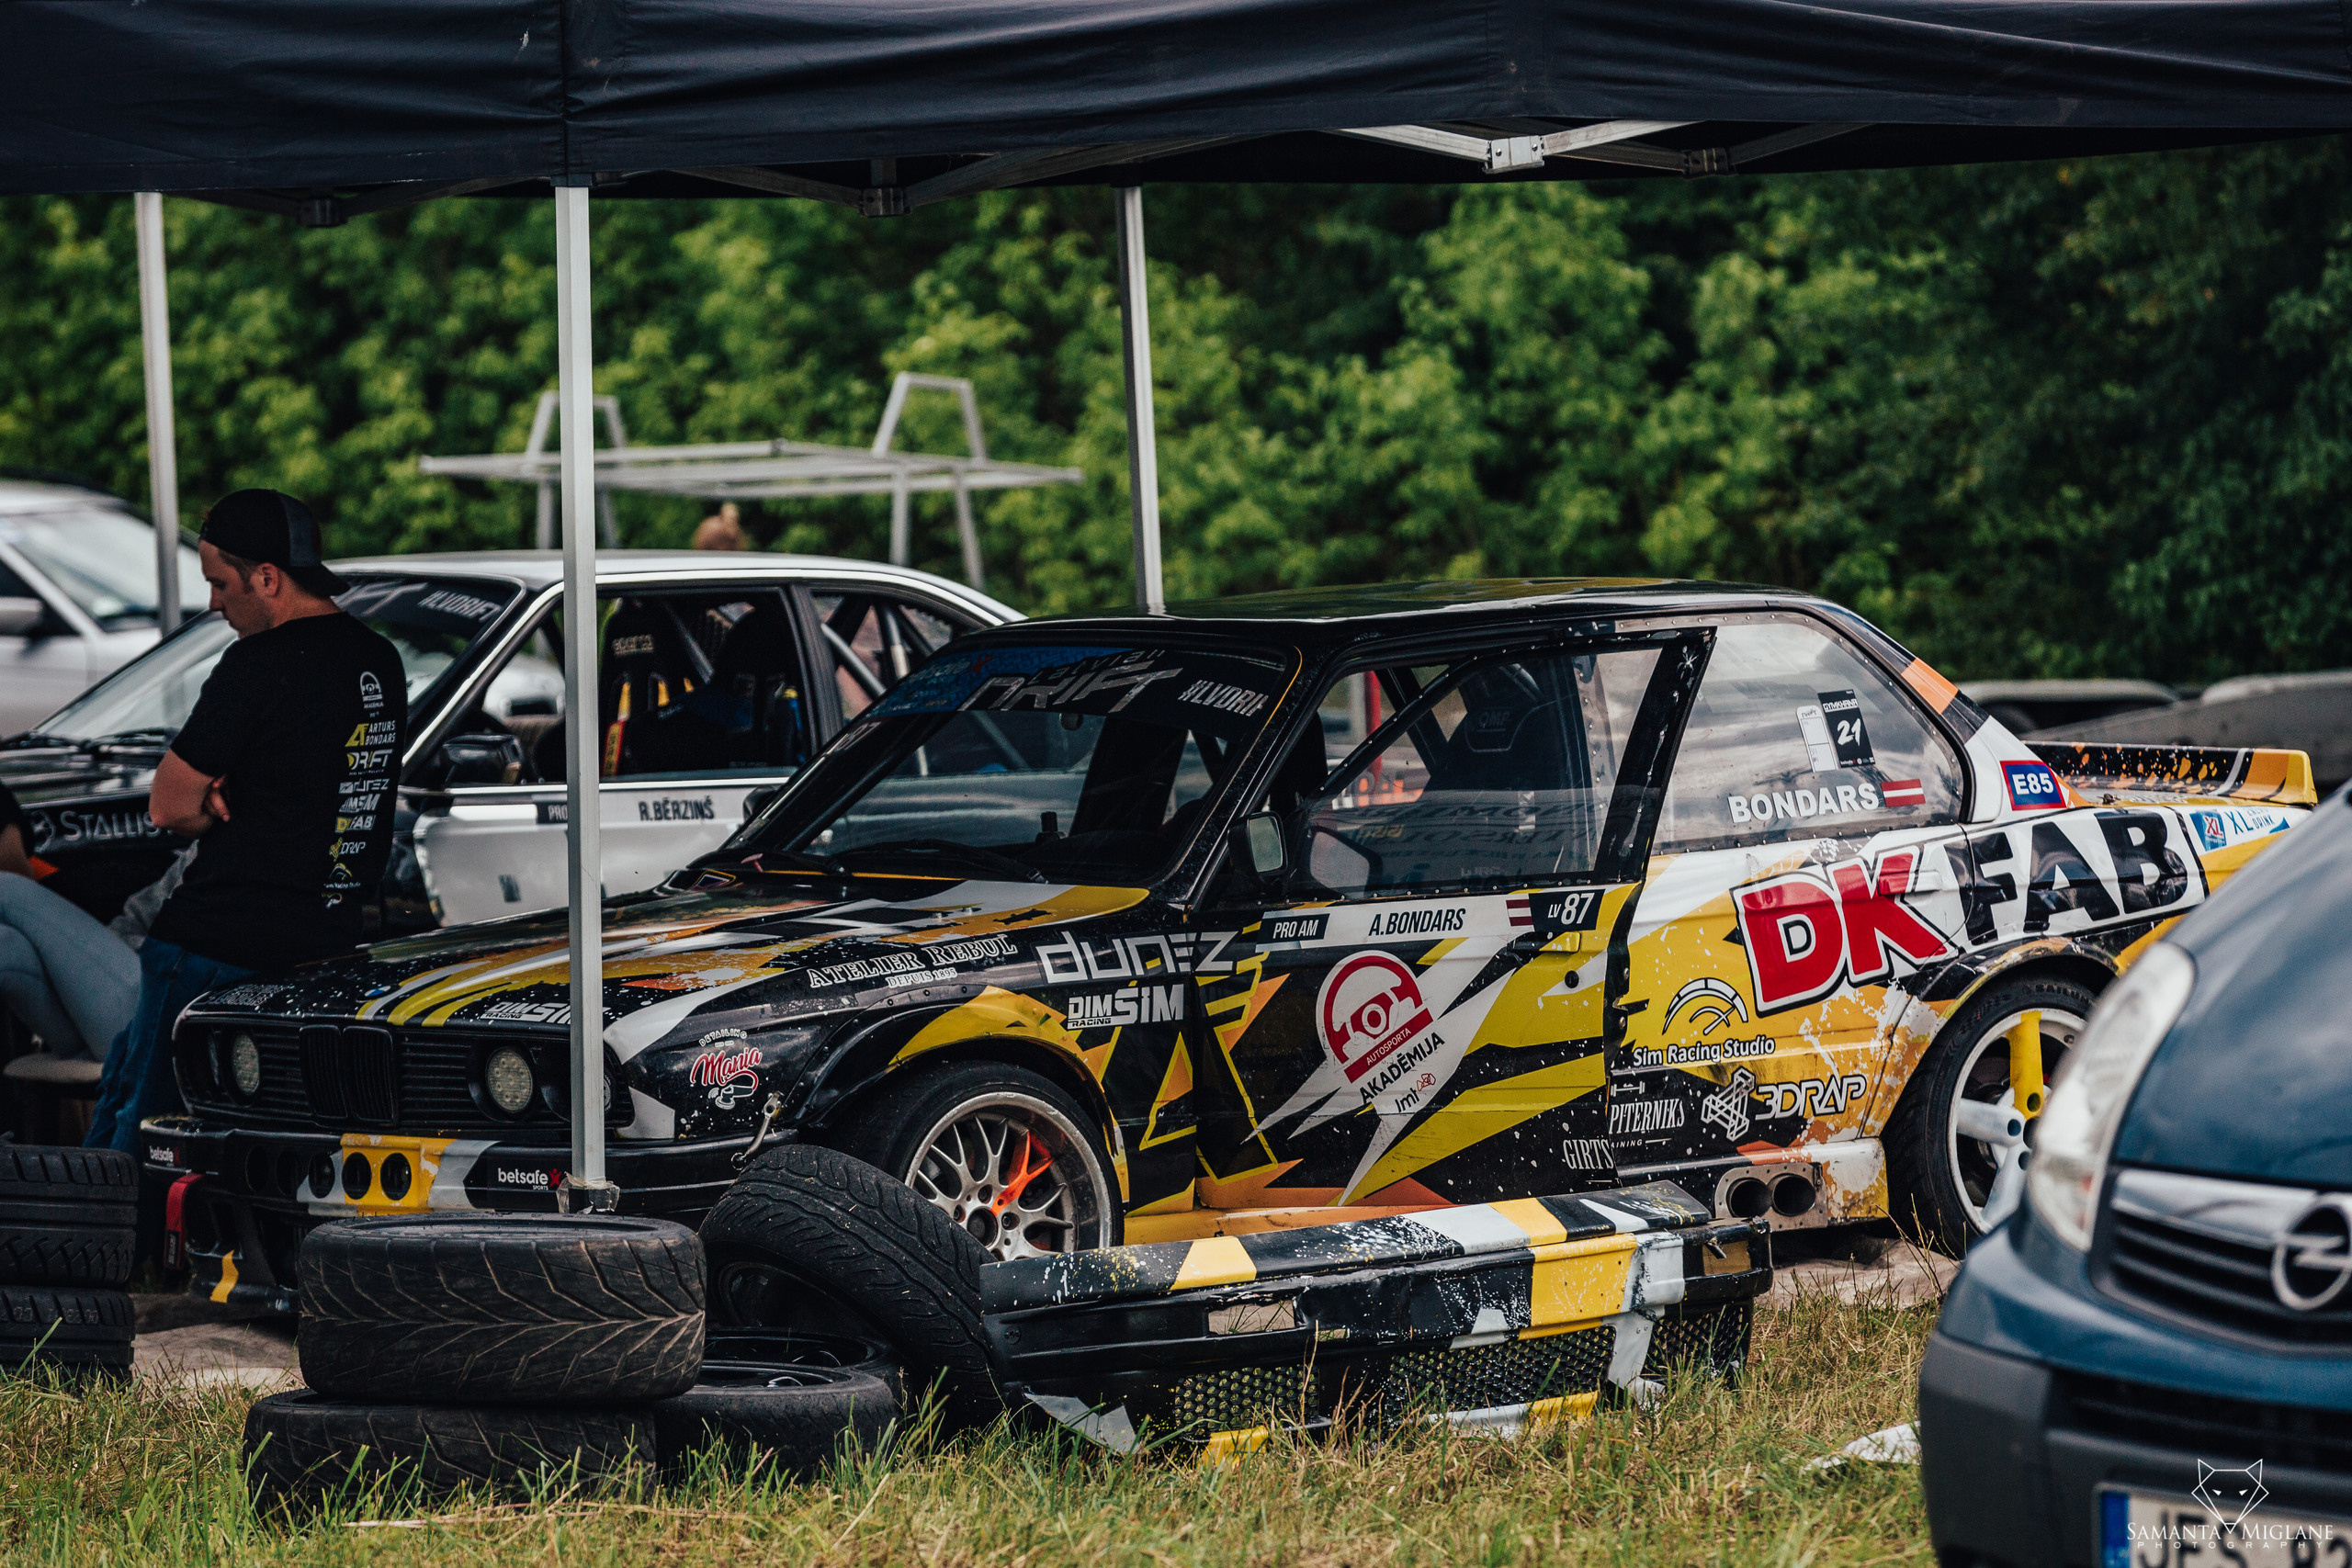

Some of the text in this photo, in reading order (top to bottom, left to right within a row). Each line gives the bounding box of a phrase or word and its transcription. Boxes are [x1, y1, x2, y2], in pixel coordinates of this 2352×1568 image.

[365, 733, 396, 746] BONDARS
[368, 720, 396, 734] ARTURS
[1837, 717, 1861, 747] 21
[2012, 773, 2054, 795] E85
[1727, 783, 1880, 823] BONDARS
[2204, 816, 2223, 837] XL
[2224, 810, 2254, 835] XL
[1368, 908, 1467, 937] A.BONDARS
[1548, 892, 1595, 925] LV 87
[1272, 919, 1319, 940] PRO AM
[807, 934, 1018, 988] ATELIER REBUL
[886, 967, 957, 988] DEPUIS 1895
[699, 1028, 748, 1047] DETAILING
[1365, 1028, 1412, 1066] AUTOSPORTA
[1633, 1034, 1776, 1066] Sim Racing Studio
[690, 1047, 763, 1087] Mania
[1360, 1032, 1445, 1105] AKADĒMIJA
[1754, 1074, 1867, 1121] 3DRAP
[1609, 1098, 1685, 1134] PITERNIKS
[1563, 1139, 1614, 1170] GIRTS
[497, 1168, 548, 1185] betsafe
